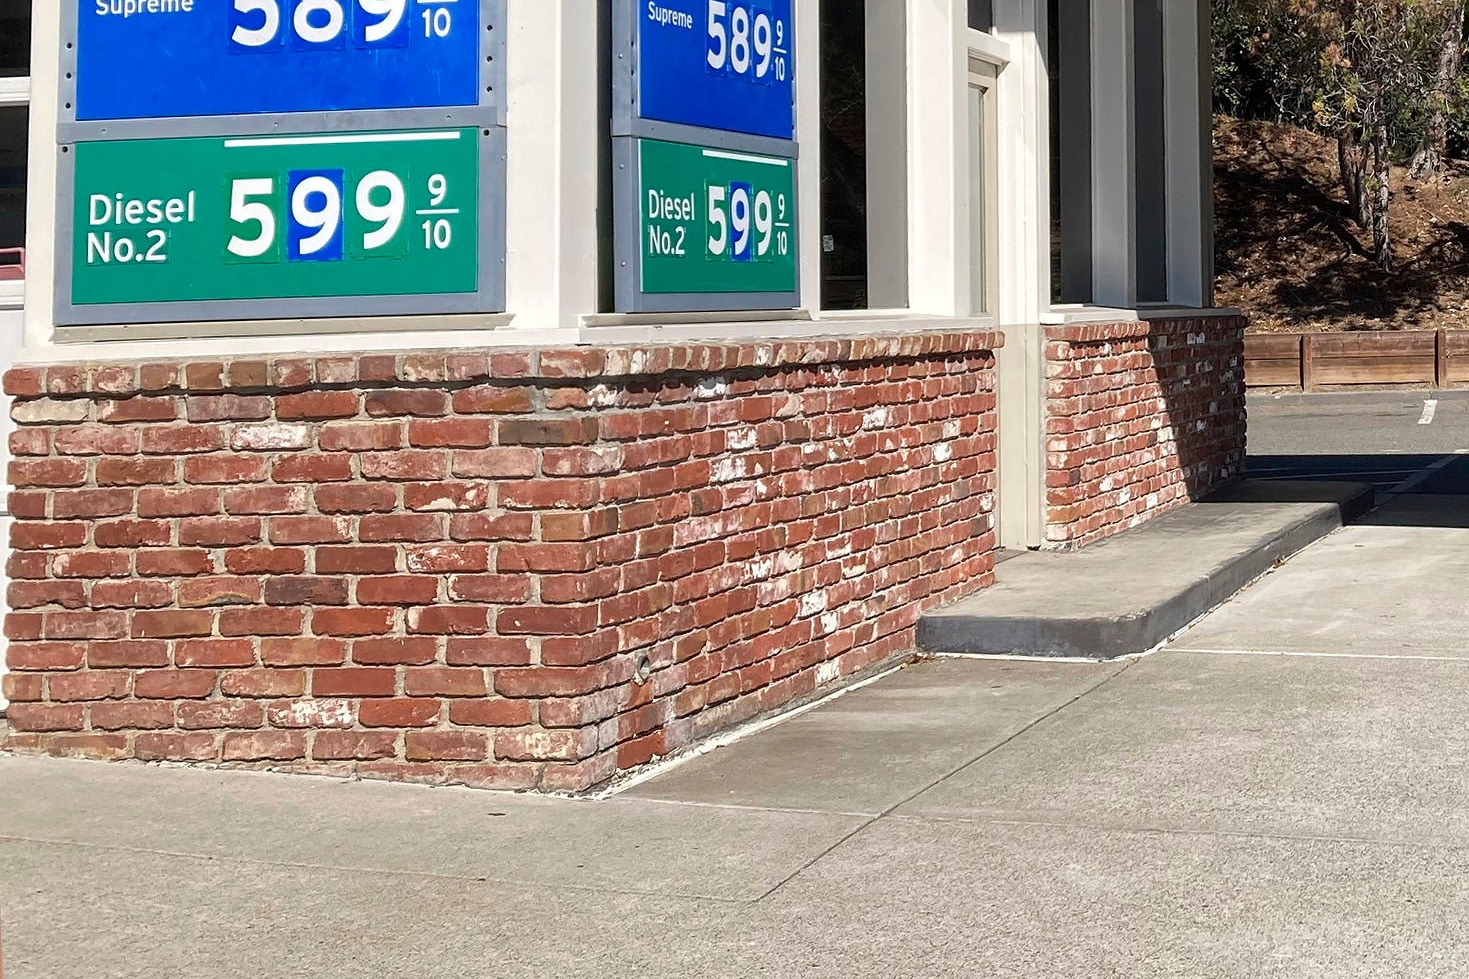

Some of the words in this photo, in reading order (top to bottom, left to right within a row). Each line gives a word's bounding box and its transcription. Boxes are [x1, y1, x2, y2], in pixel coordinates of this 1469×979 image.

[647, 1, 693, 30] Supreme
[706, 0, 773, 79] 589
[87, 229, 167, 263] No.2
[89, 190, 196, 227] Diesel
[227, 170, 405, 258] 599
[648, 189, 696, 222] Diesel
[707, 185, 773, 257] 599
[648, 225, 686, 256] No.2
